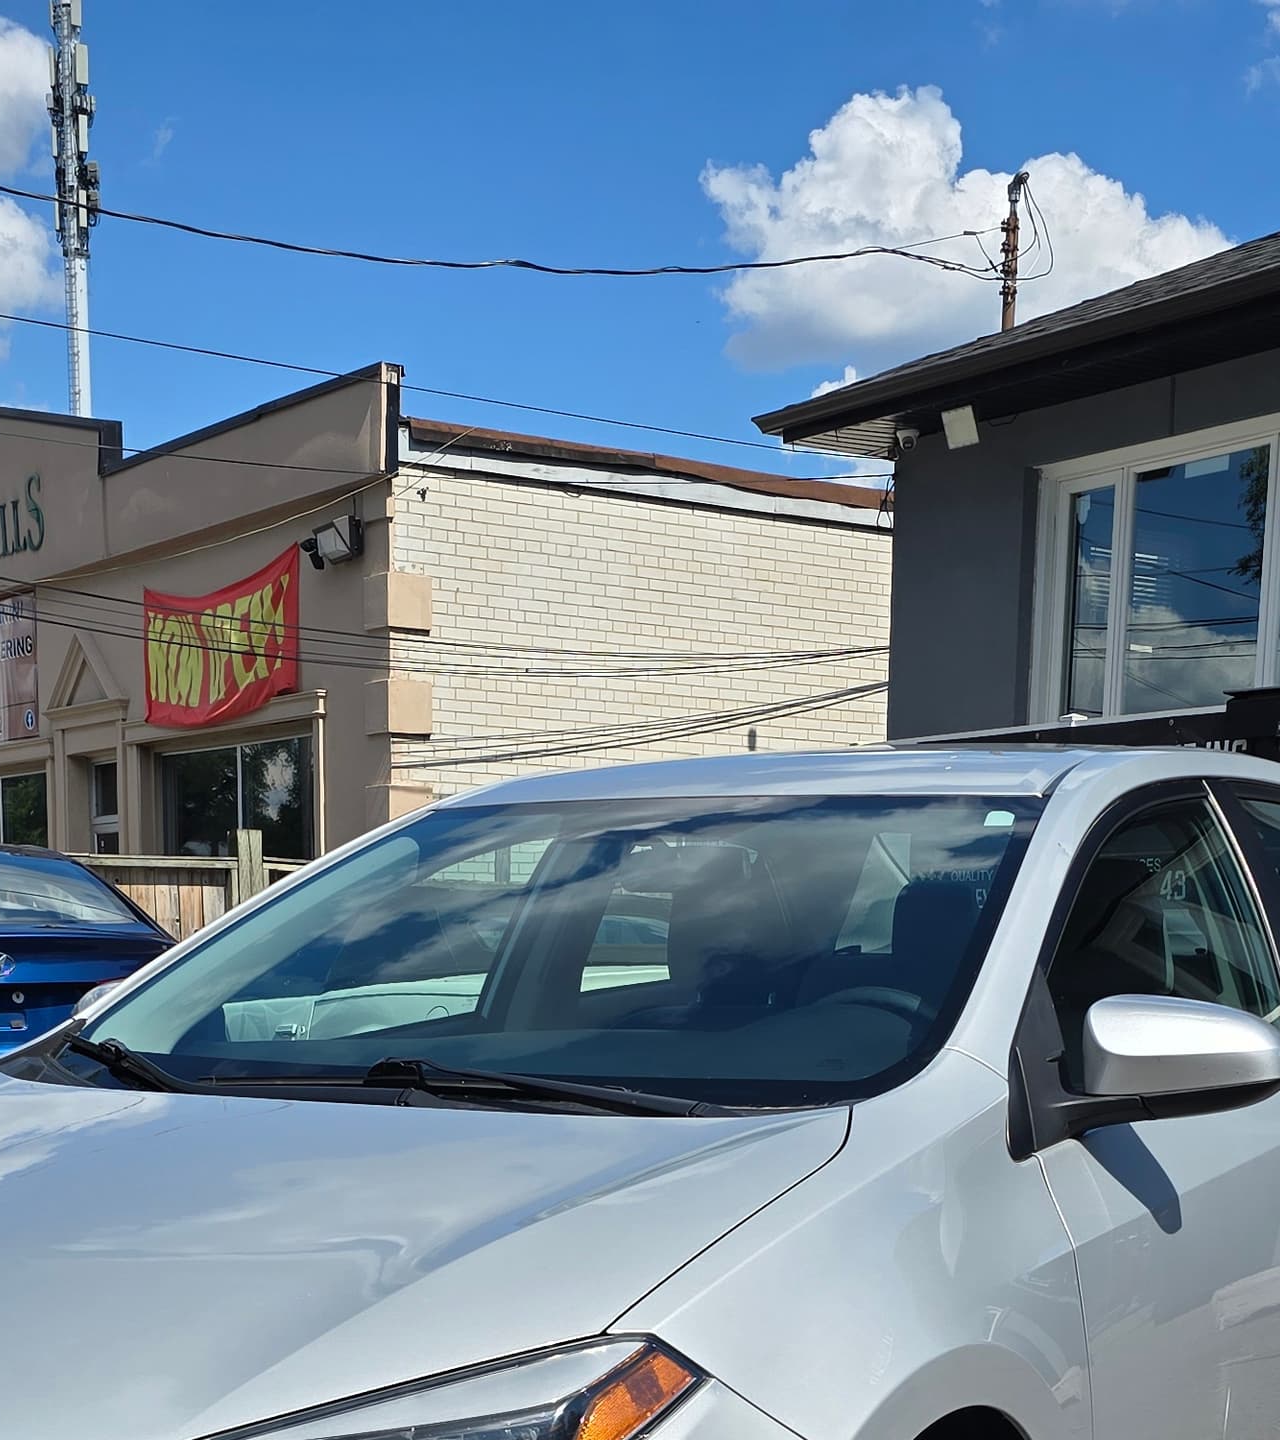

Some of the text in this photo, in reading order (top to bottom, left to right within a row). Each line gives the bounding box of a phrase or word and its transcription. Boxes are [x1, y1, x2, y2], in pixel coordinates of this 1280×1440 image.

[148, 573, 289, 707] NOW OPEN!
[951, 869, 994, 881] QUALITY
[1160, 870, 1187, 900] 43
